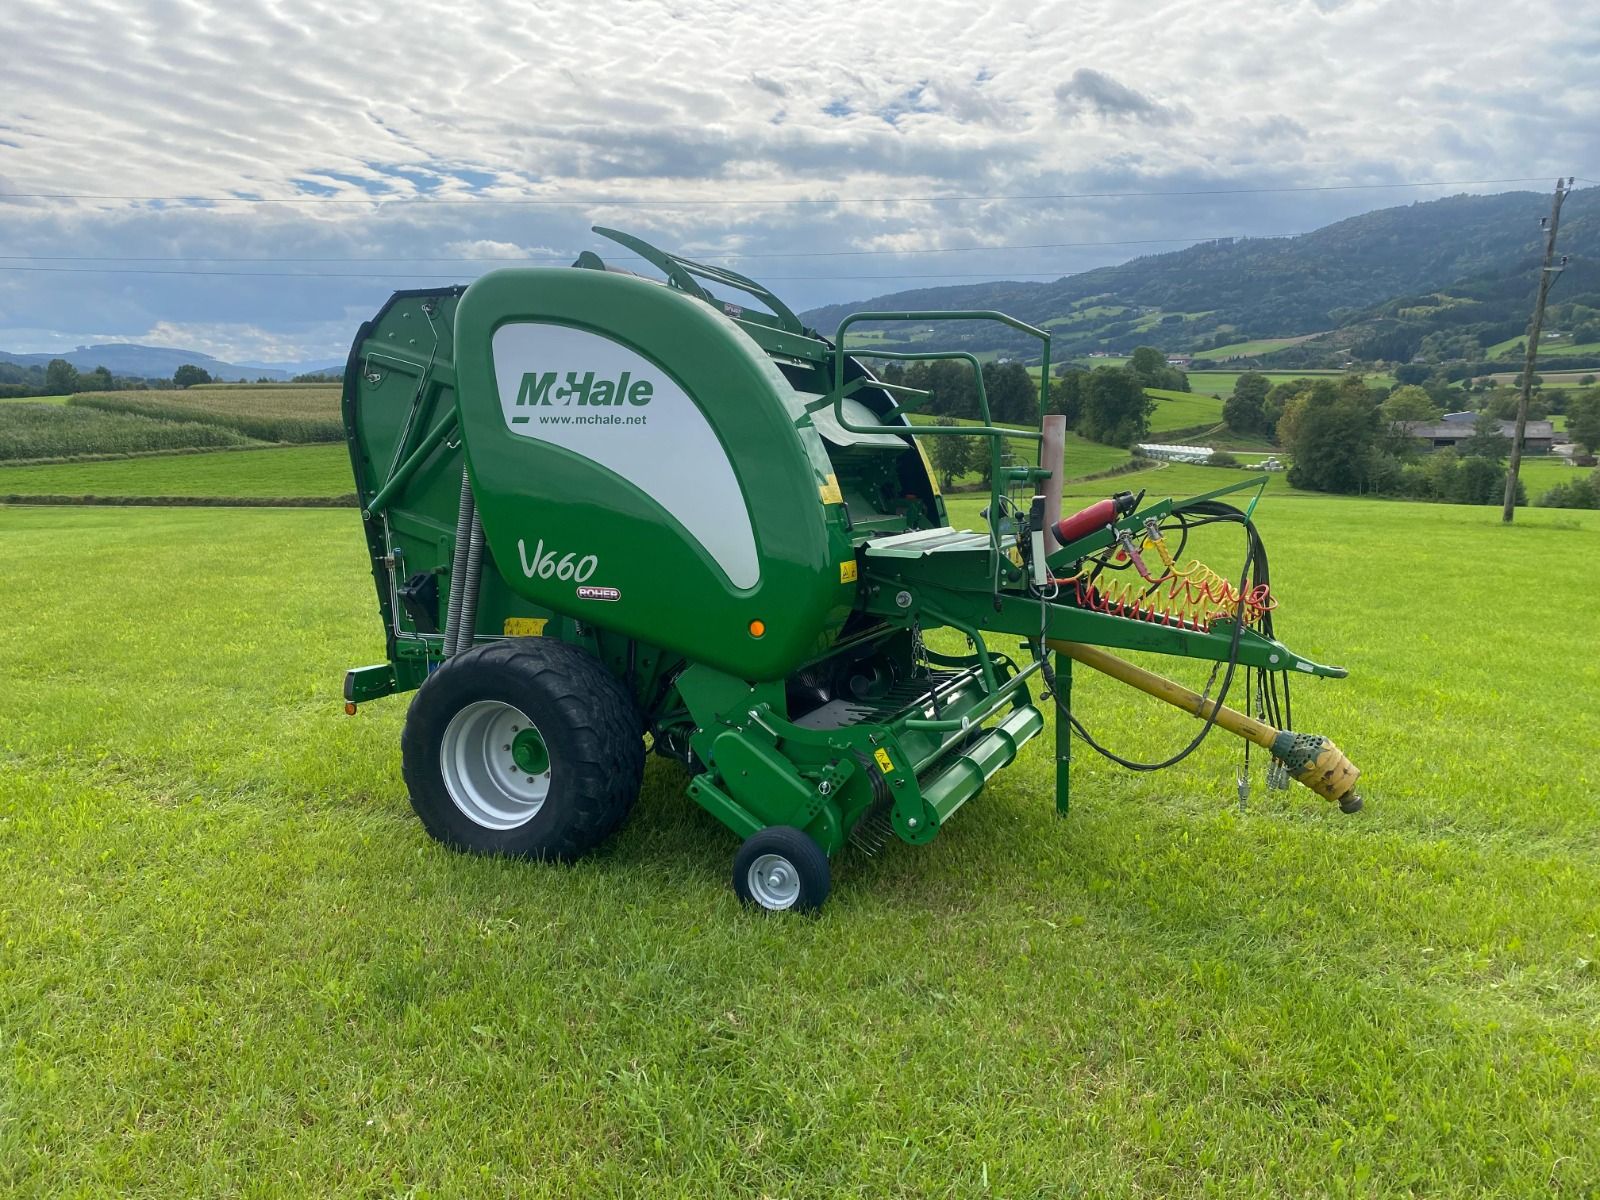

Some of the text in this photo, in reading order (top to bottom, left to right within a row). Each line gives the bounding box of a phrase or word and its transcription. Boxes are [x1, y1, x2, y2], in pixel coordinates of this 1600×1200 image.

[515, 371, 654, 407] McHale
[539, 414, 647, 425] www.mchale.net
[517, 538, 598, 583] V660
